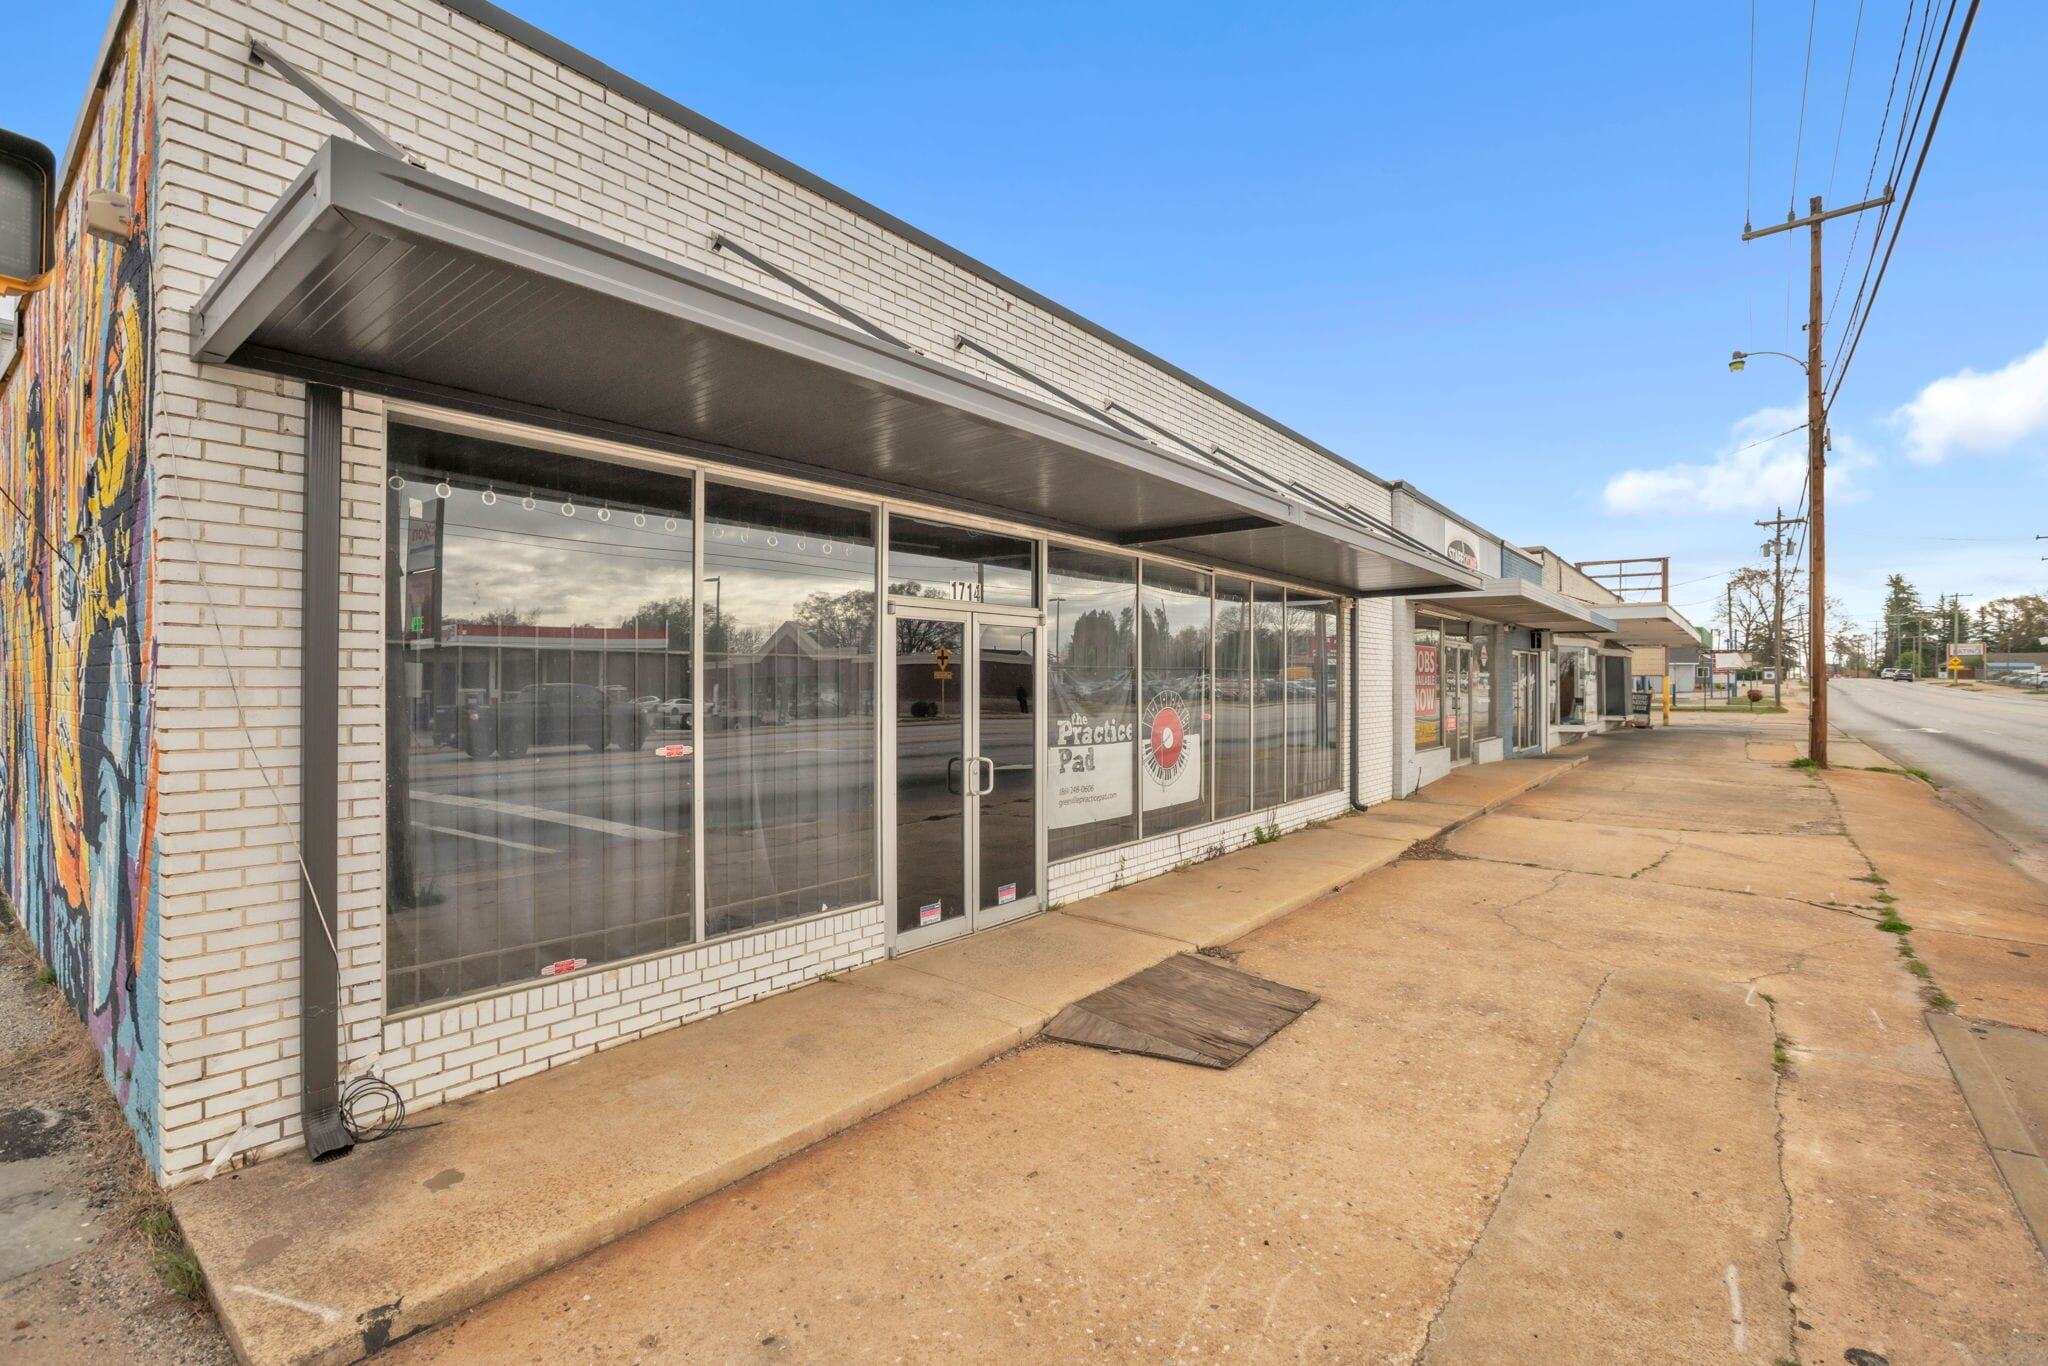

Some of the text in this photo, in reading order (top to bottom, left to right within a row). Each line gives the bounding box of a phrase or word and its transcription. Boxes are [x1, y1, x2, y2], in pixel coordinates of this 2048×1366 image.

[951, 581, 980, 602] 1714
[1071, 712, 1088, 725] the
[1056, 718, 1133, 745] Practice
[1058, 747, 1095, 774] Pad
